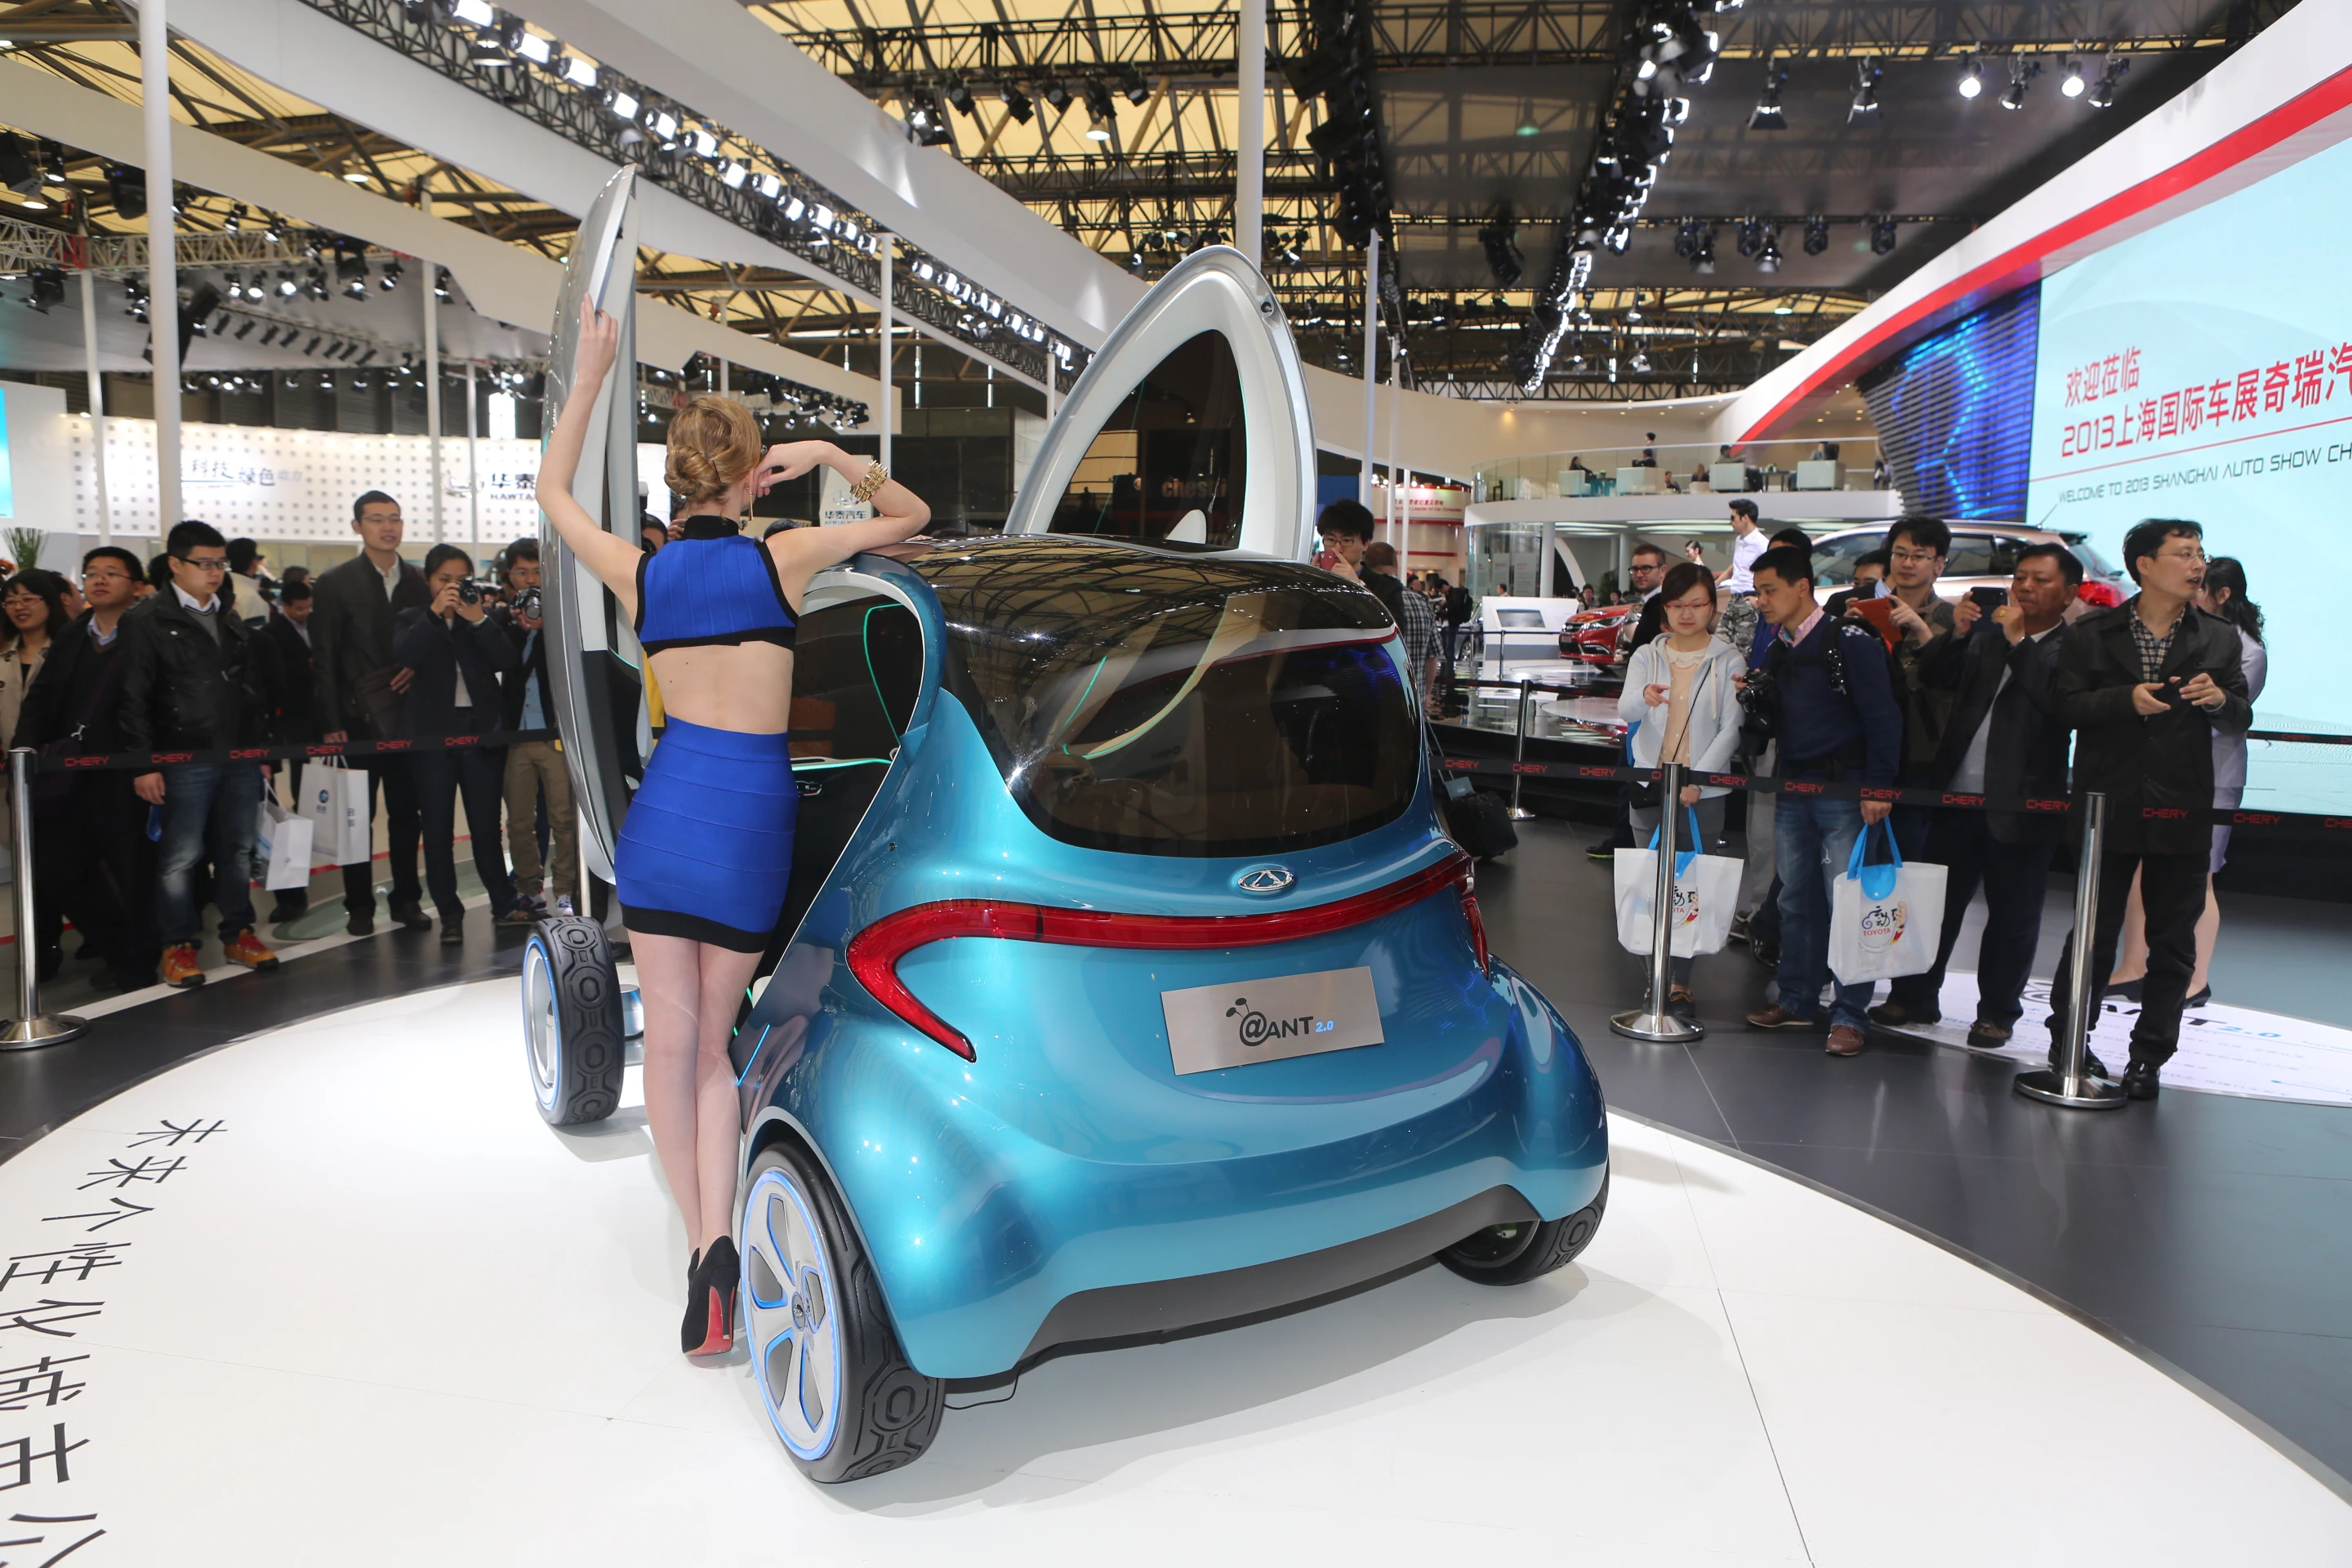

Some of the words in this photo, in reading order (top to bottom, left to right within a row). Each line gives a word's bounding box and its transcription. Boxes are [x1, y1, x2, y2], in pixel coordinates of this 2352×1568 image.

[2065, 346, 2141, 408] 欢迎莅临
[2059, 484, 2105, 504] WELCOME
[2109, 481, 2123, 496] TO
[2125, 477, 2149, 494] 2013
[2153, 465, 2218, 490] SHANGHAI
[2222, 457, 2264, 479] AUTO
[2270, 448, 2322, 471] SHOW
[825, 510, 866, 520] 华泰汽车
[65, 756, 109, 768] CHERY
[151, 753, 193, 764] CHERY
[230, 749, 270, 760] CHERY
[306, 745, 344, 755] CHERY
[376, 740, 412, 751] CHERY
[445, 736, 479, 746] CHERY
[1445, 759, 1480, 769] CHERY
[1512, 763, 1548, 773] CHERY
[1579, 767, 1616, 777] CHERY
[1710, 774, 1748, 786] CHERY
[1784, 782, 1824, 794] CHERY
[1860, 788, 1902, 800] CHERY
[1942, 794, 1985, 806] CHERY
[2026, 799, 2071, 811] CHERY
[2142, 808, 2189, 819] CHERY
[2233, 813, 2281, 825] CHERY
[2325, 817, 2352, 829] CHE
[1864, 928, 1891, 937] TOYOTA
[1315, 1020, 1334, 1033] 2.0
